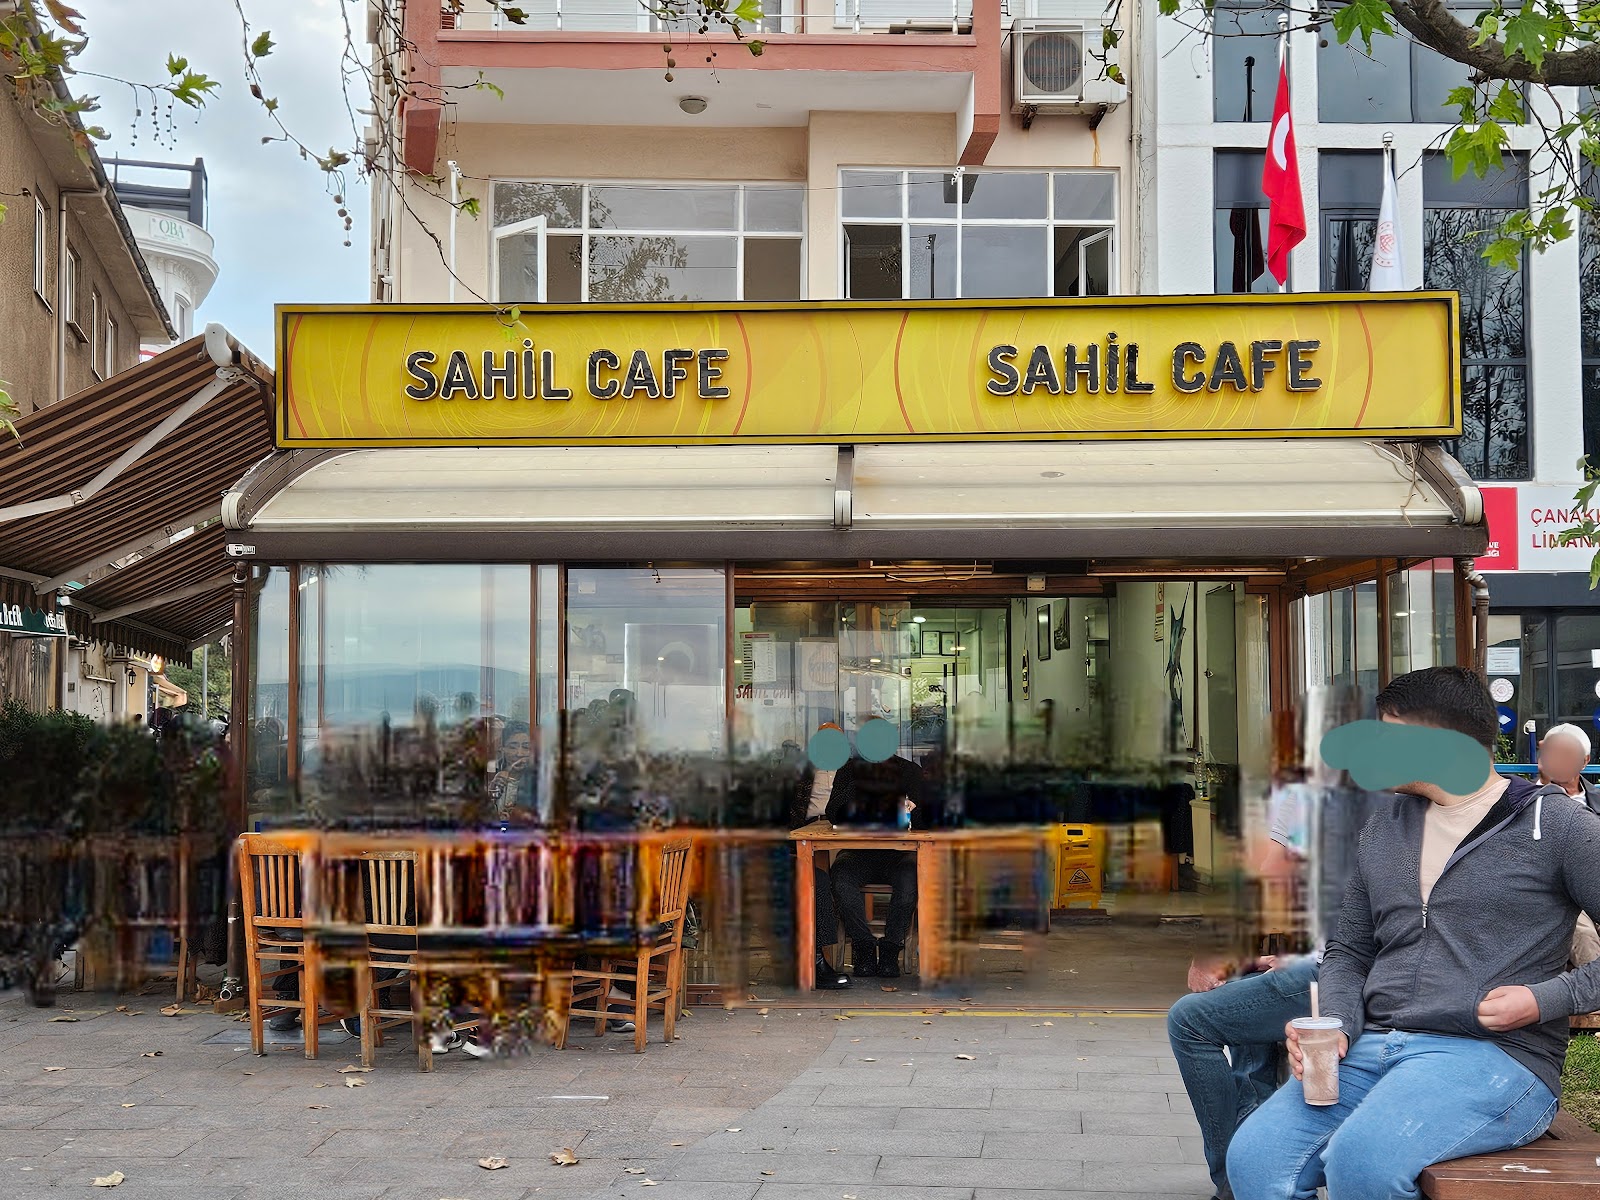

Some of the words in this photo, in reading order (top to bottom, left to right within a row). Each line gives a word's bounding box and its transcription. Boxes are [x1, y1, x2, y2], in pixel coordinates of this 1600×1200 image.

[404, 337, 573, 401] SAHİL
[585, 348, 732, 401] CAFE
[985, 330, 1156, 396] SAHİL
[1171, 339, 1323, 393] CAFE
